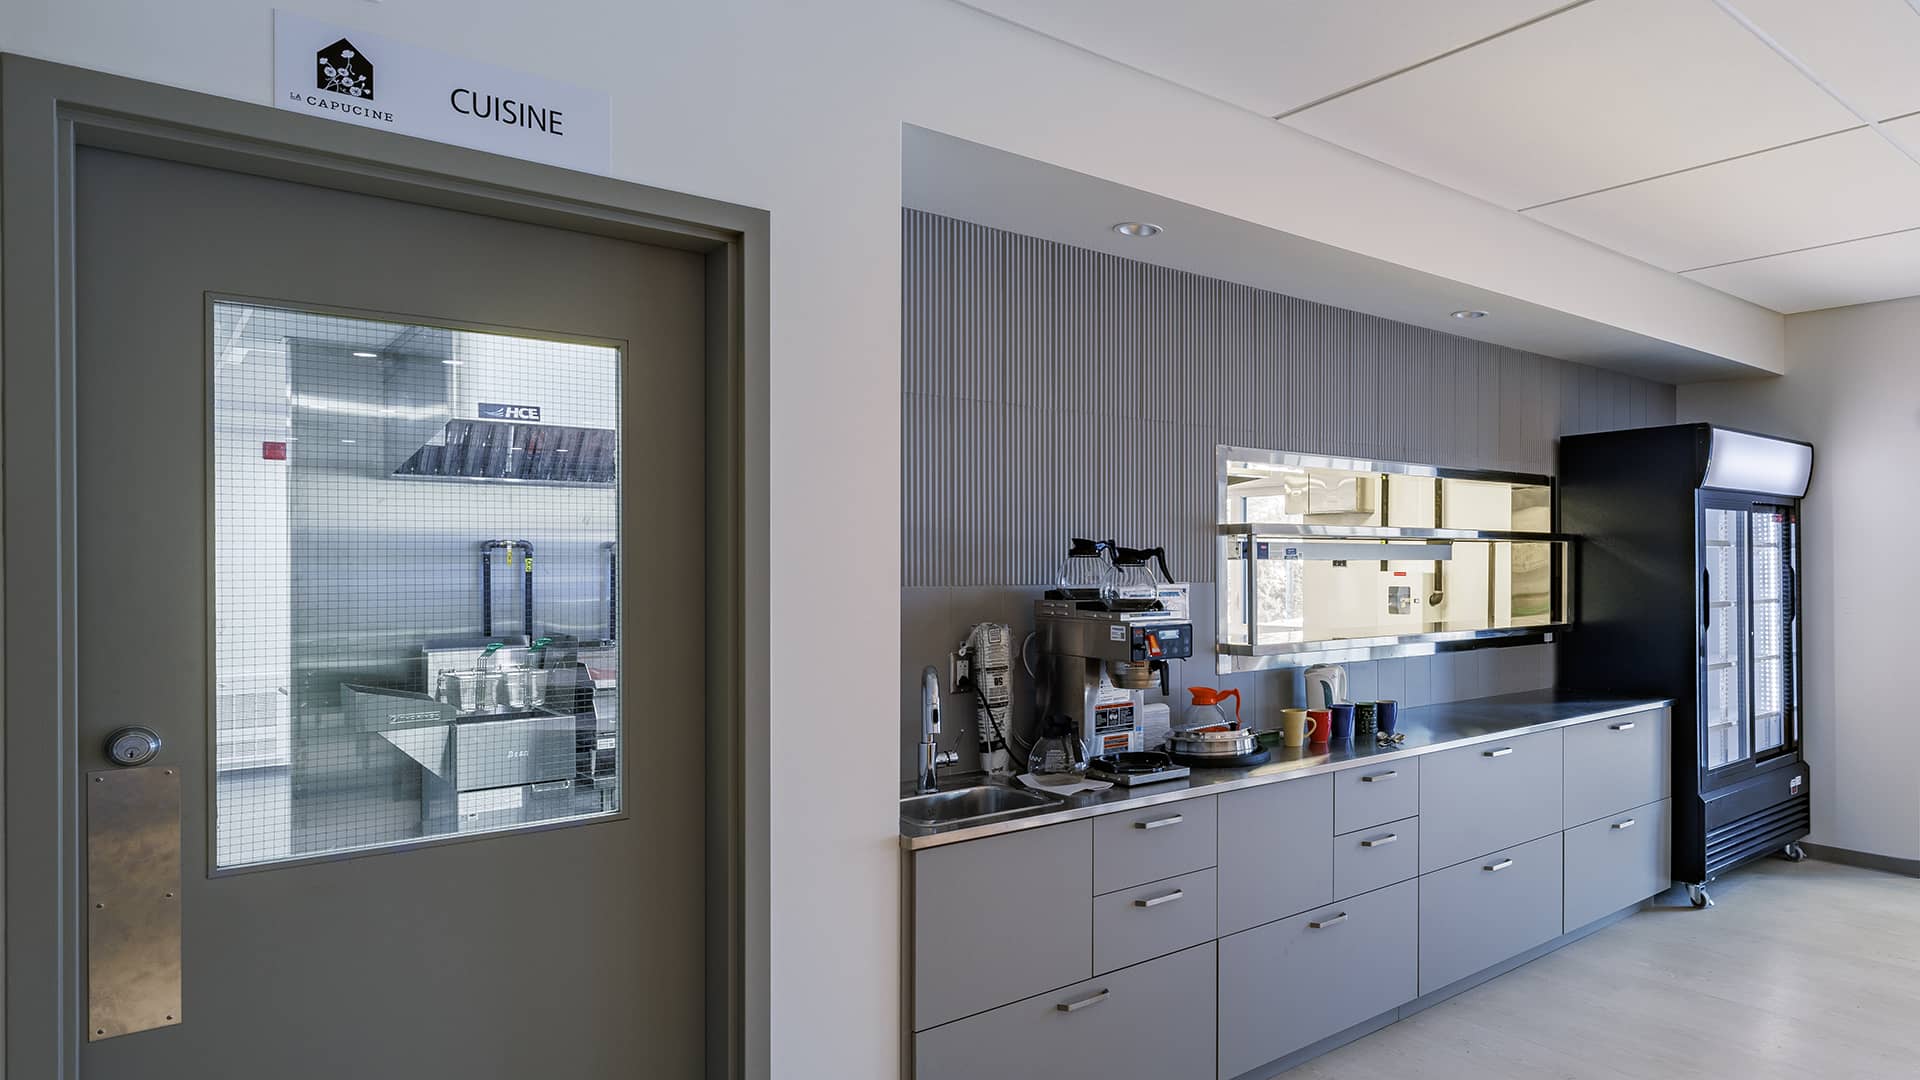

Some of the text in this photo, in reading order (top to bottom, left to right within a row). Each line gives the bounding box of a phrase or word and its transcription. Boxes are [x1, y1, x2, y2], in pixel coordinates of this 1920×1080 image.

[290, 92, 393, 122] LA CAPUCINE
[451, 88, 564, 135] CUISINE
[505, 407, 539, 420] HCE
